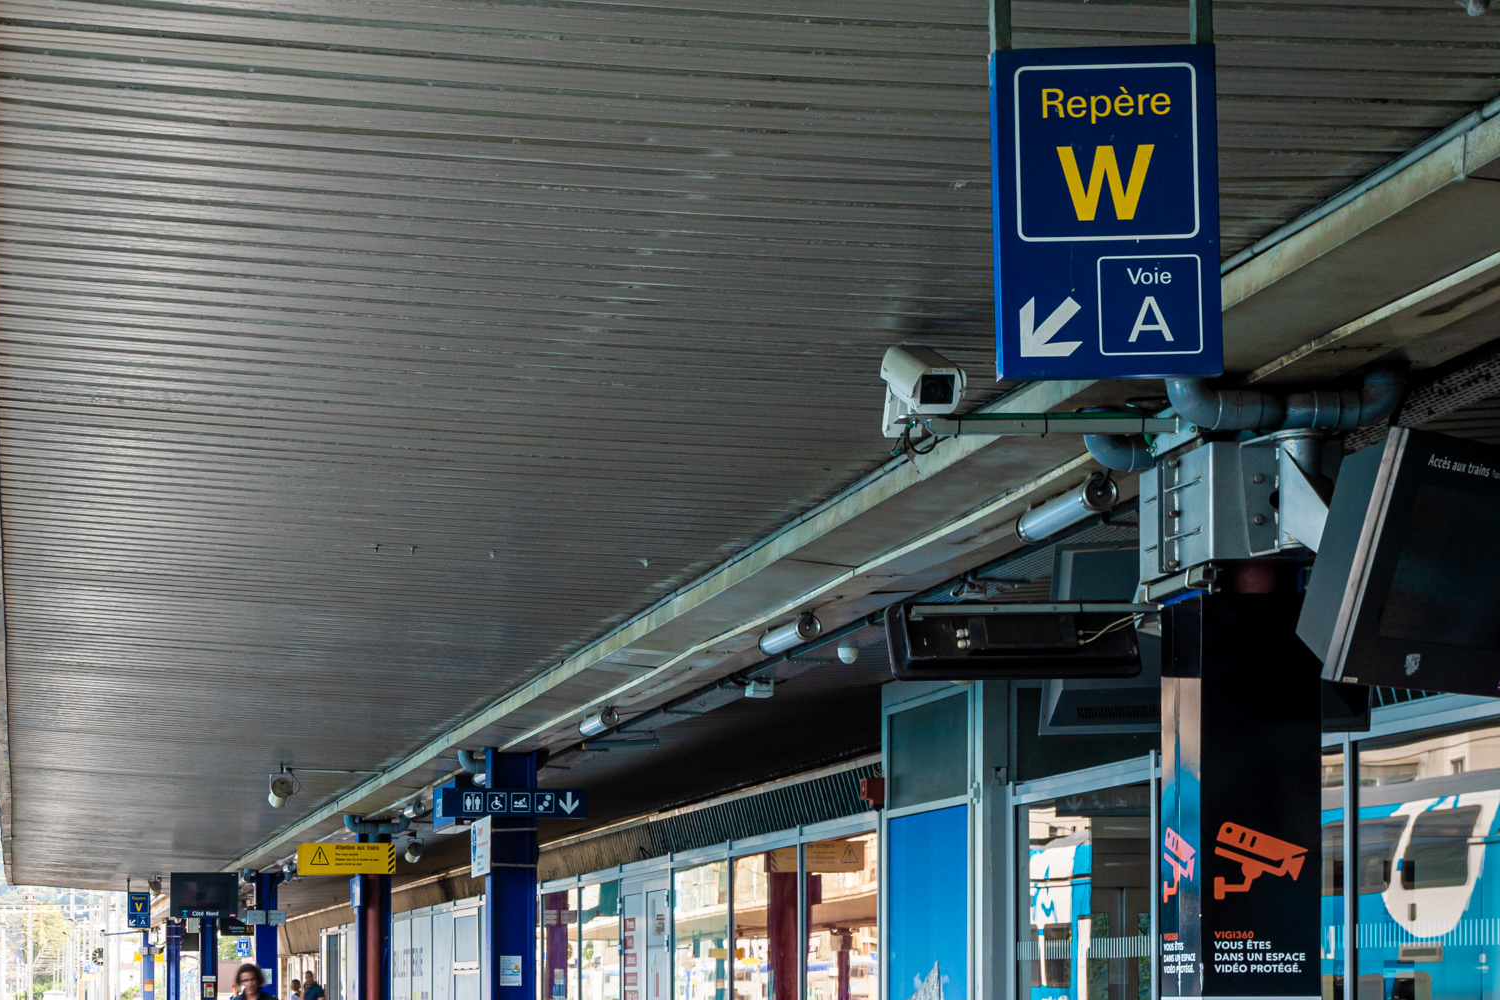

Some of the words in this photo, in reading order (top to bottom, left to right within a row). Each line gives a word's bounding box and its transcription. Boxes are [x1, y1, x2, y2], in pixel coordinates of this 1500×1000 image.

[1041, 86, 1172, 125] Repère
[1056, 143, 1155, 222] W
[1126, 267, 1173, 285] Voie
[1128, 296, 1175, 343] A
[1428, 453, 1451, 470] Accès
[1452, 461, 1467, 473] aux
[1467, 462, 1491, 478] trains
[135, 902, 143, 912] V
[192, 909, 204, 917] Côté
[1214, 931, 1254, 939] VIGI360
[1163, 943, 1174, 951] VOUS
[1214, 941, 1243, 949] VOUS
[1246, 939, 1271, 949] ÊTES
[1163, 954, 1174, 963] DANS
[1181, 953, 1196, 962] ESPACE
[1214, 953, 1244, 961] DANS
[1247, 953, 1263, 961] UN
[1266, 953, 1306, 961] ESPACE
[1214, 963, 1247, 973] VIDÉO
[1250, 963, 1302, 973] PROTÉGÉ.
